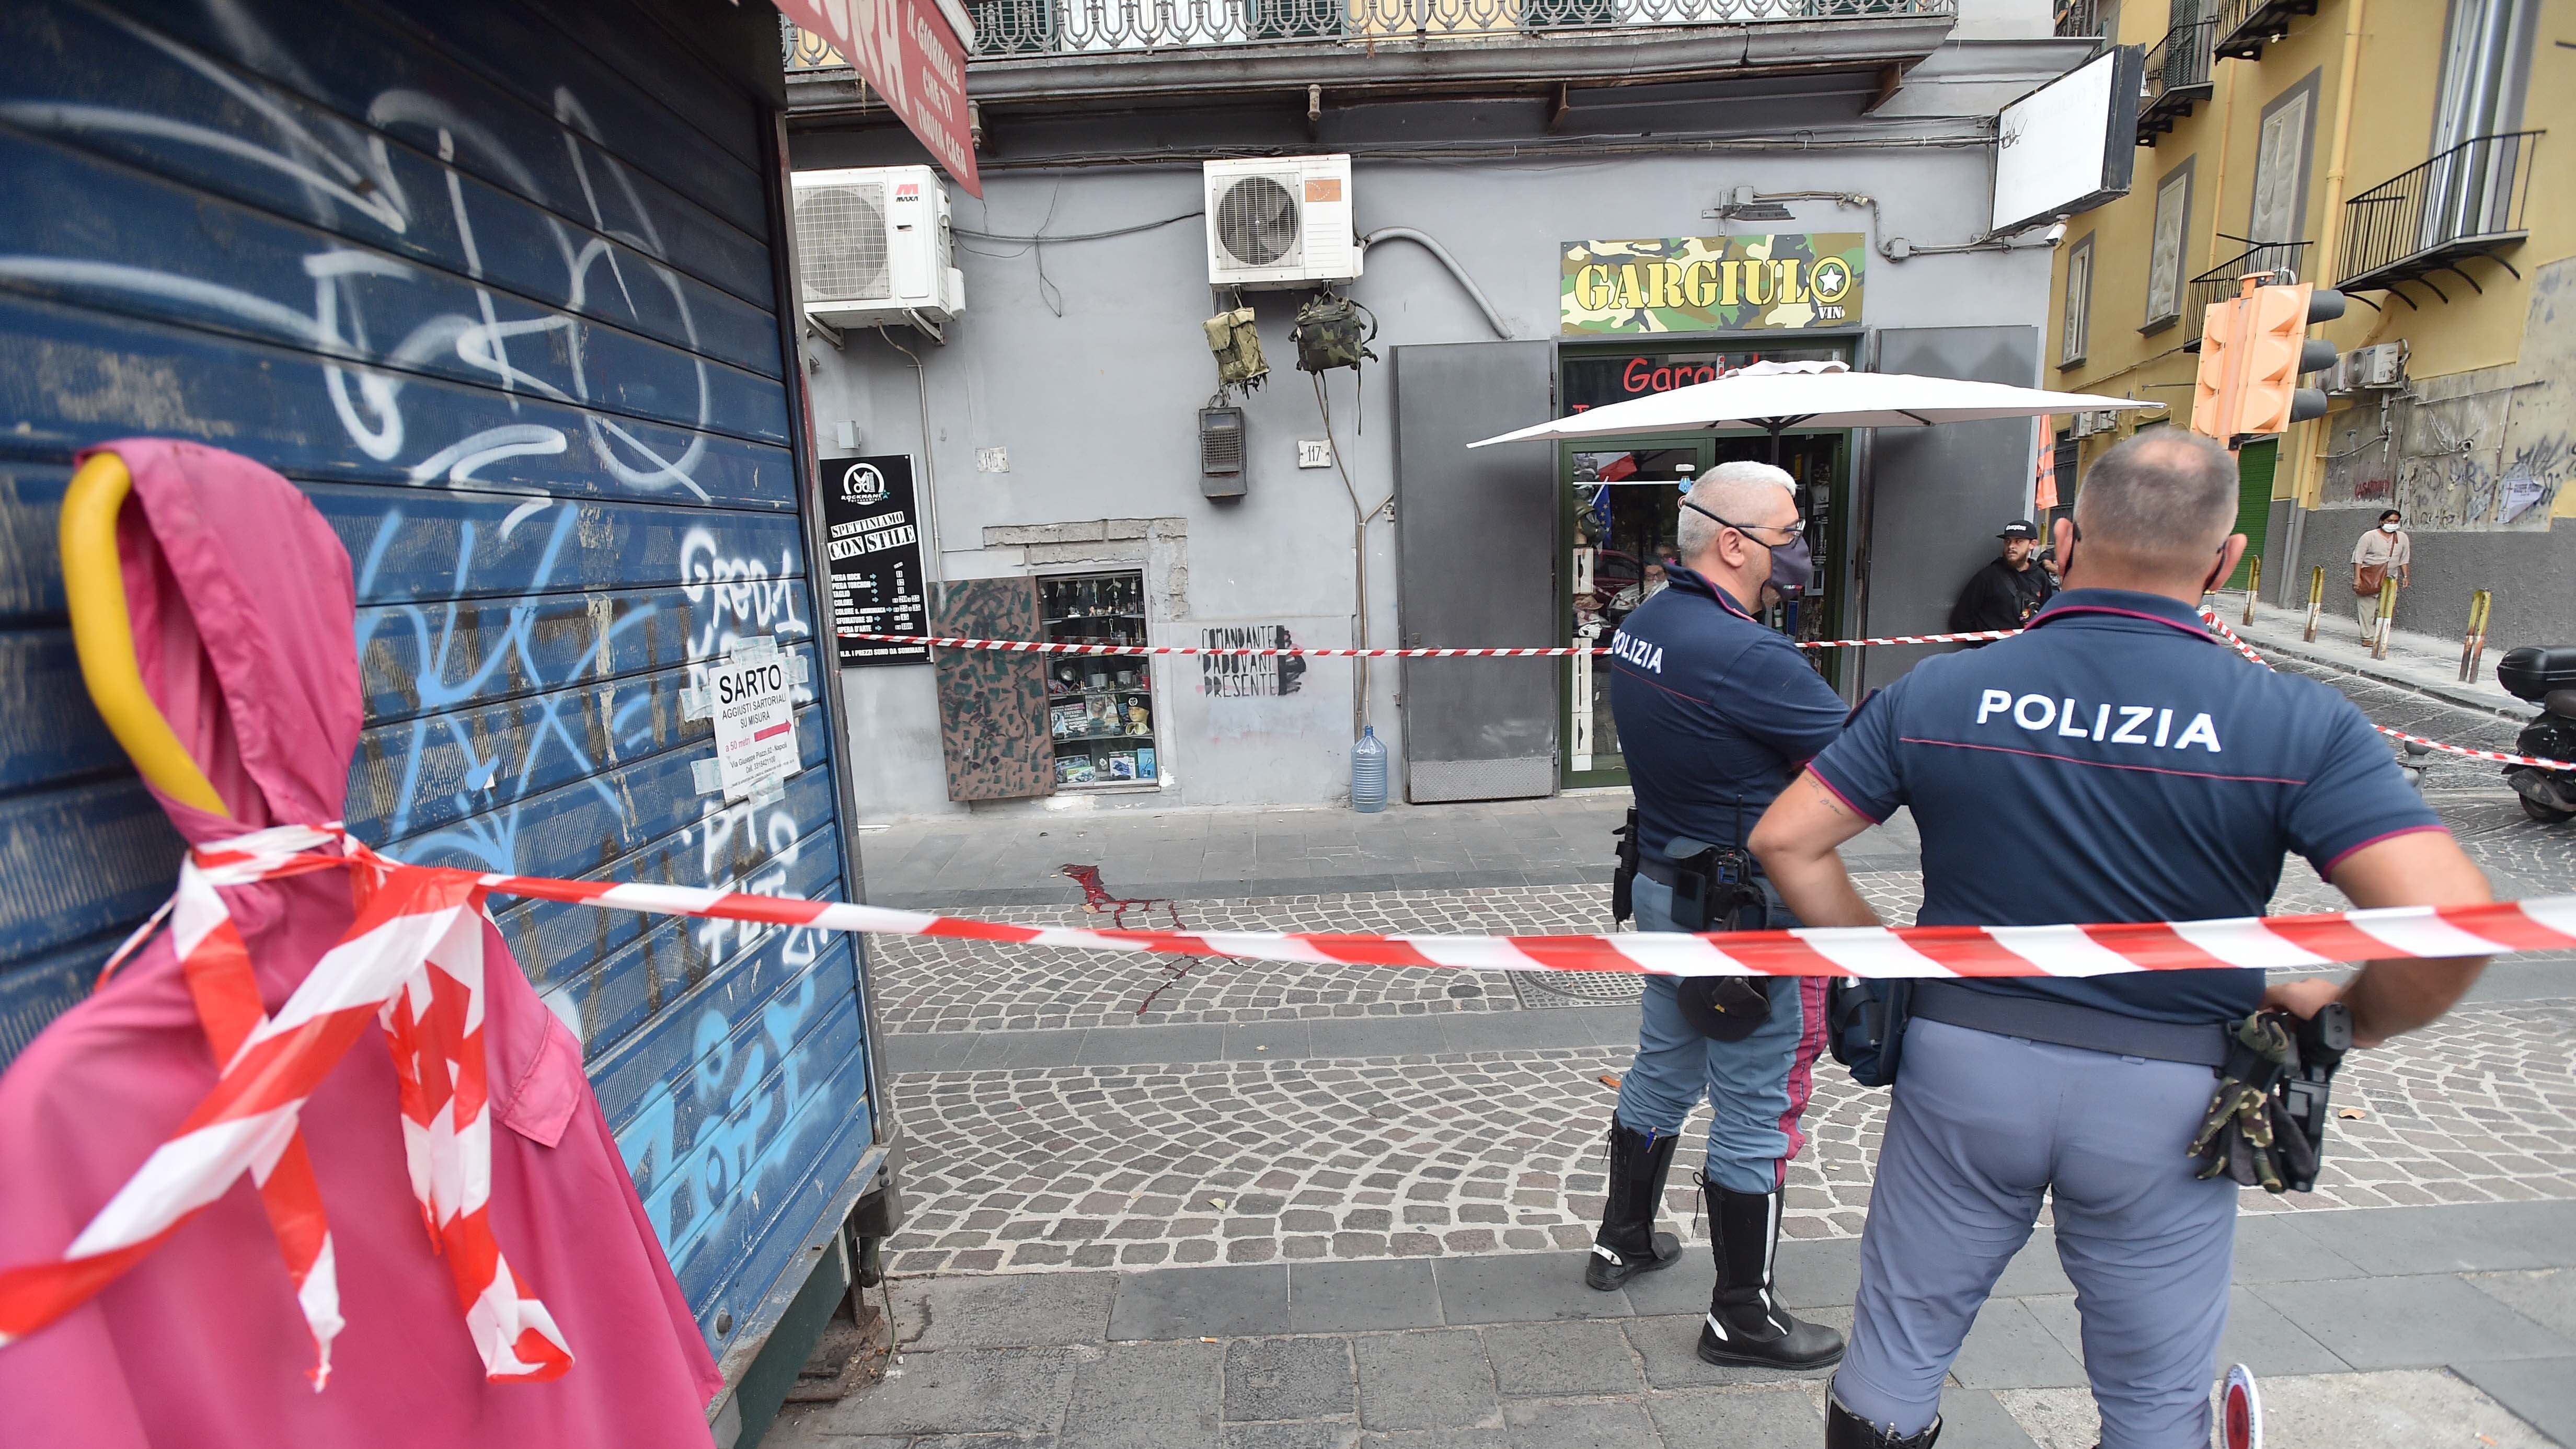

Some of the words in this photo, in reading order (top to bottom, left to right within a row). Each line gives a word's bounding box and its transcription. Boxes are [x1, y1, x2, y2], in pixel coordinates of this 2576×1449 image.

[907, 1, 916, 40] IL
[917, 16, 961, 95] GIORNALE
[922, 66, 943, 112] CHE
[938, 87, 953, 122] TI
[914, 97, 947, 155] TROVA
[945, 131, 968, 179] CASA
[1574, 256, 1852, 310] GARGIULO
[1818, 305, 1843, 319] VIN
[1308, 445, 1321, 462] 117
[832, 512, 903, 537] SPETTINIAMO
[830, 537, 862, 558] CON
[867, 526, 915, 551] STILE
[1202, 625, 1274, 649] COMANDANTE
[1612, 628, 1663, 674] POLIZIA
[719, 664, 781, 704] SARTO
[1204, 673, 1277, 698] PRESENTE
[722, 705, 752, 720] AGGIUSTI
[753, 694, 786, 711] SARTORIALI
[740, 718, 748, 729] SU
[749, 710, 770, 726] MISURA
[1976, 688, 2222, 753] POLIZIA
[730, 741, 737, 750] 50
[738, 738, 750, 749] metri
[730, 759, 740, 768] Via
[739, 754, 756, 766] Giuseppe
[775, 742, 787, 753] Napoli
